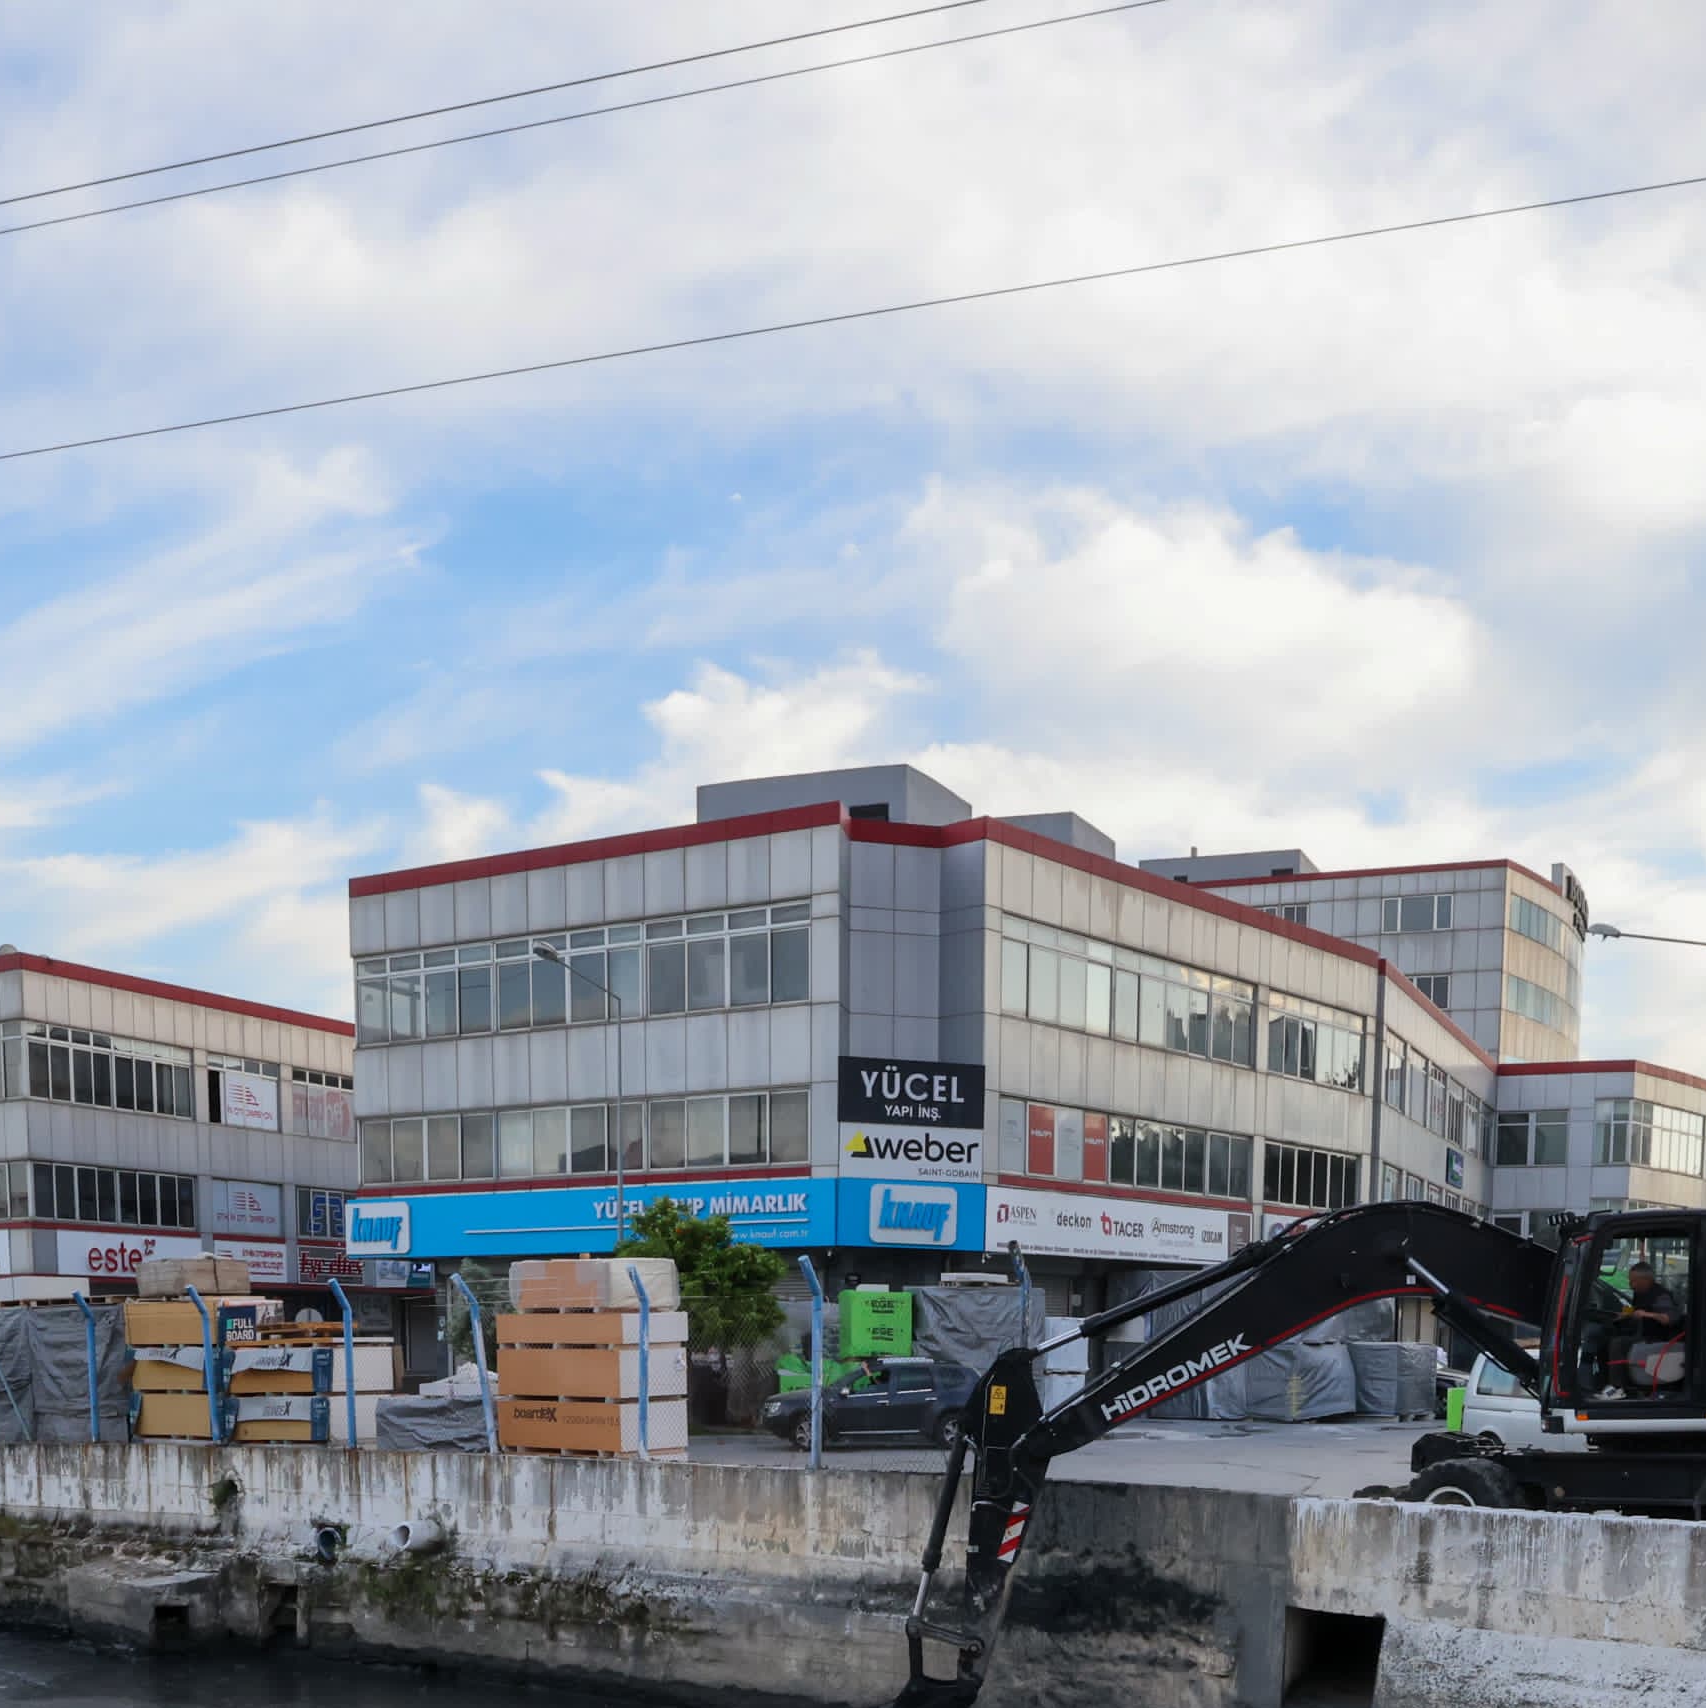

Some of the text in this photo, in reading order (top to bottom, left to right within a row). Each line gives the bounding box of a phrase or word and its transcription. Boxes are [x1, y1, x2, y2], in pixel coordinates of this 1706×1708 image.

[860, 1065, 965, 1103] YÜCEL
[884, 1103, 942, 1121] YAPI İNŞ.
[873, 1132, 979, 1164] weber
[917, 1167, 980, 1179] SAINT-GOBAIN
[709, 1191, 807, 1215] MİMARLIK
[1010, 1205, 1038, 1220] ASPEN
[878, 1188, 951, 1242] KNAUF
[1056, 1212, 1092, 1229] deckon
[351, 1207, 403, 1250] KNAUF
[1113, 1220, 1144, 1238] TACER
[1152, 1217, 1195, 1239] Armstrong
[89, 1241, 143, 1273] este
[232, 1318, 254, 1329] FULL
[226, 1330, 254, 1342] BOARD
